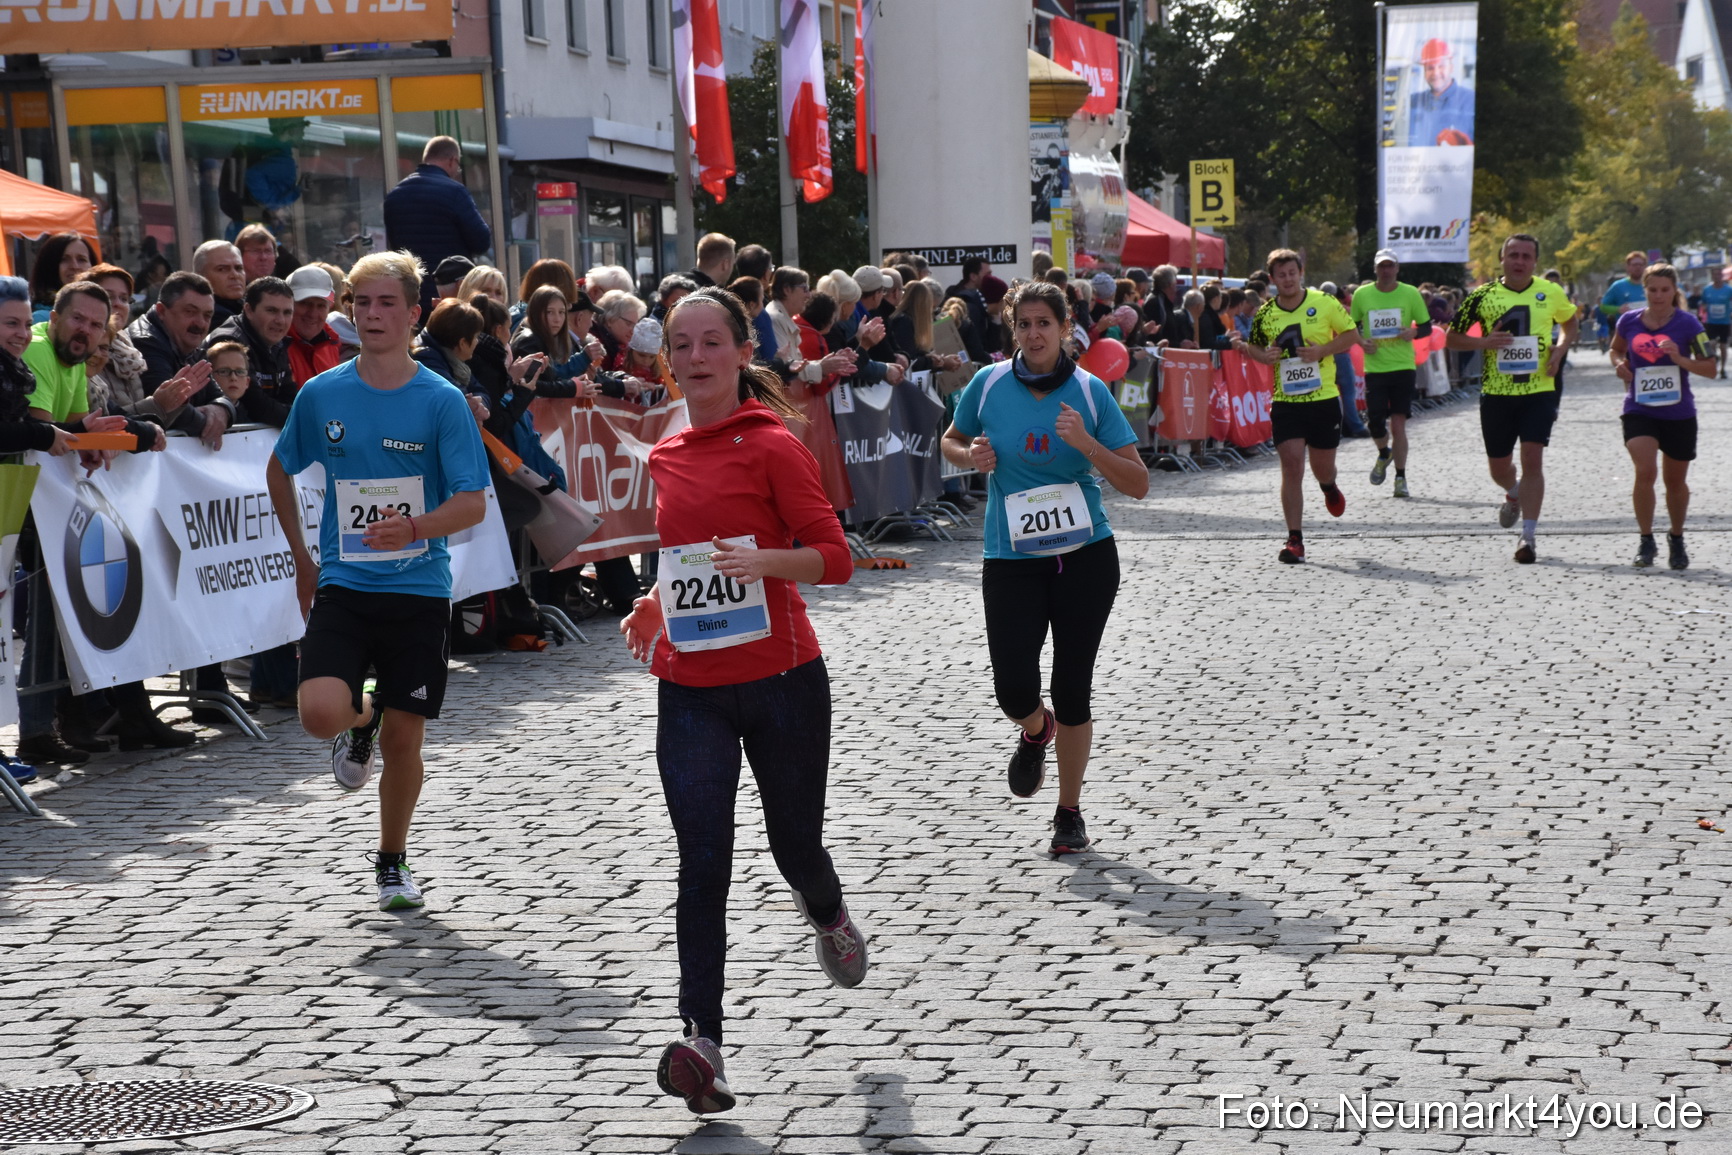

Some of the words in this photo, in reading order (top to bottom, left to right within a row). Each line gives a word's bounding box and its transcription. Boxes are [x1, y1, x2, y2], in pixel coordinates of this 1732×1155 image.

[199, 88, 362, 114] RUNMARKT.DE
[1194, 163, 1229, 175] Block
[1201, 180, 1224, 212] B
[1387, 225, 1442, 240] swn
[1373, 317, 1397, 328] 2483
[1502, 348, 1533, 360] 2666
[1285, 367, 1315, 381] 2662
[1641, 377, 1674, 392] 2206
[383, 438, 425, 452] BOCK
[367, 486, 398, 495] BOCK
[1034, 491, 1062, 502] BOCK
[350, 502, 411, 529] 243
[1020, 506, 1076, 535] 2011
[181, 497, 240, 551] BMW
[1038, 535, 1068, 547] Kerstin
[688, 551, 721, 564] BOC
[195, 558, 257, 596] WENIGER
[671, 574, 746, 611] 2240
[697, 619, 728, 632] Elvine
